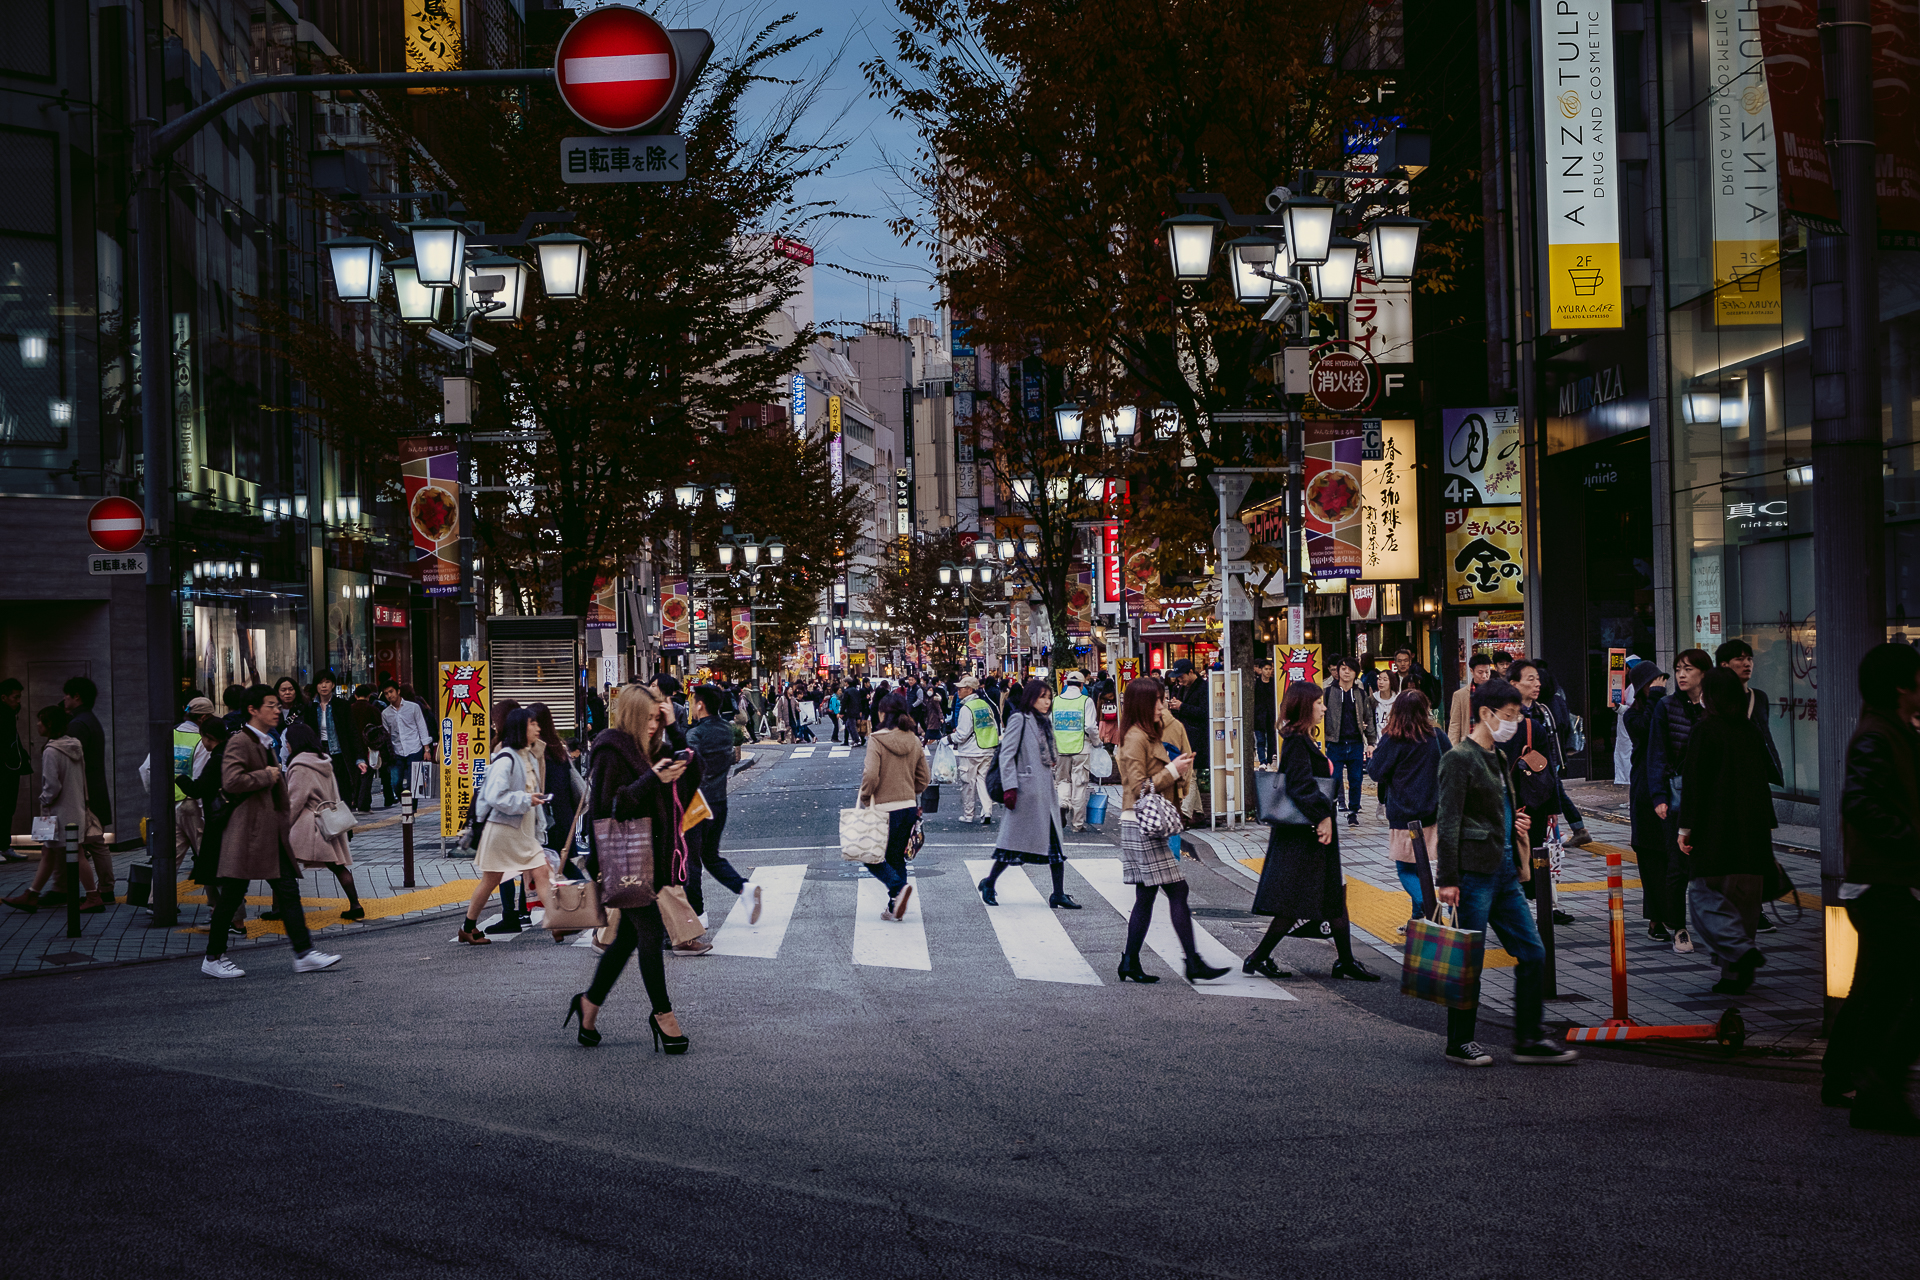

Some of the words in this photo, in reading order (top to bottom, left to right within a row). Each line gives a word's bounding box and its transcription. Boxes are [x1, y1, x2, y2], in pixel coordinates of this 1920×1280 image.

[1588, 11, 1602, 100] COSMETIC
[1591, 107, 1603, 144] AND
[568, 145, 679, 172] 自転車を除く
[1561, 125, 1585, 226] AINZ
[1592, 151, 1604, 198] DRUG
[1576, 255, 1592, 267] 2F
[1556, 304, 1587, 313] AYURA
[1589, 304, 1615, 312] CAFE
[1317, 370, 1365, 393] 消火栓
[1362, 430, 1380, 449] C
[1444, 478, 1474, 503] 4F
[1445, 509, 1464, 525] B1
[1467, 520, 1522, 536] きんくら
[93, 558, 143, 572] 自転車を除く
[1310, 555, 1361, 565] 新宿中央通発展会
[1317, 568, 1361, 576] 防犯カメラ作動中
[1454, 537, 1523, 594] 金の
[1288, 648, 1310, 681] 注意
[472, 712, 486, 793] 路上の居酒
